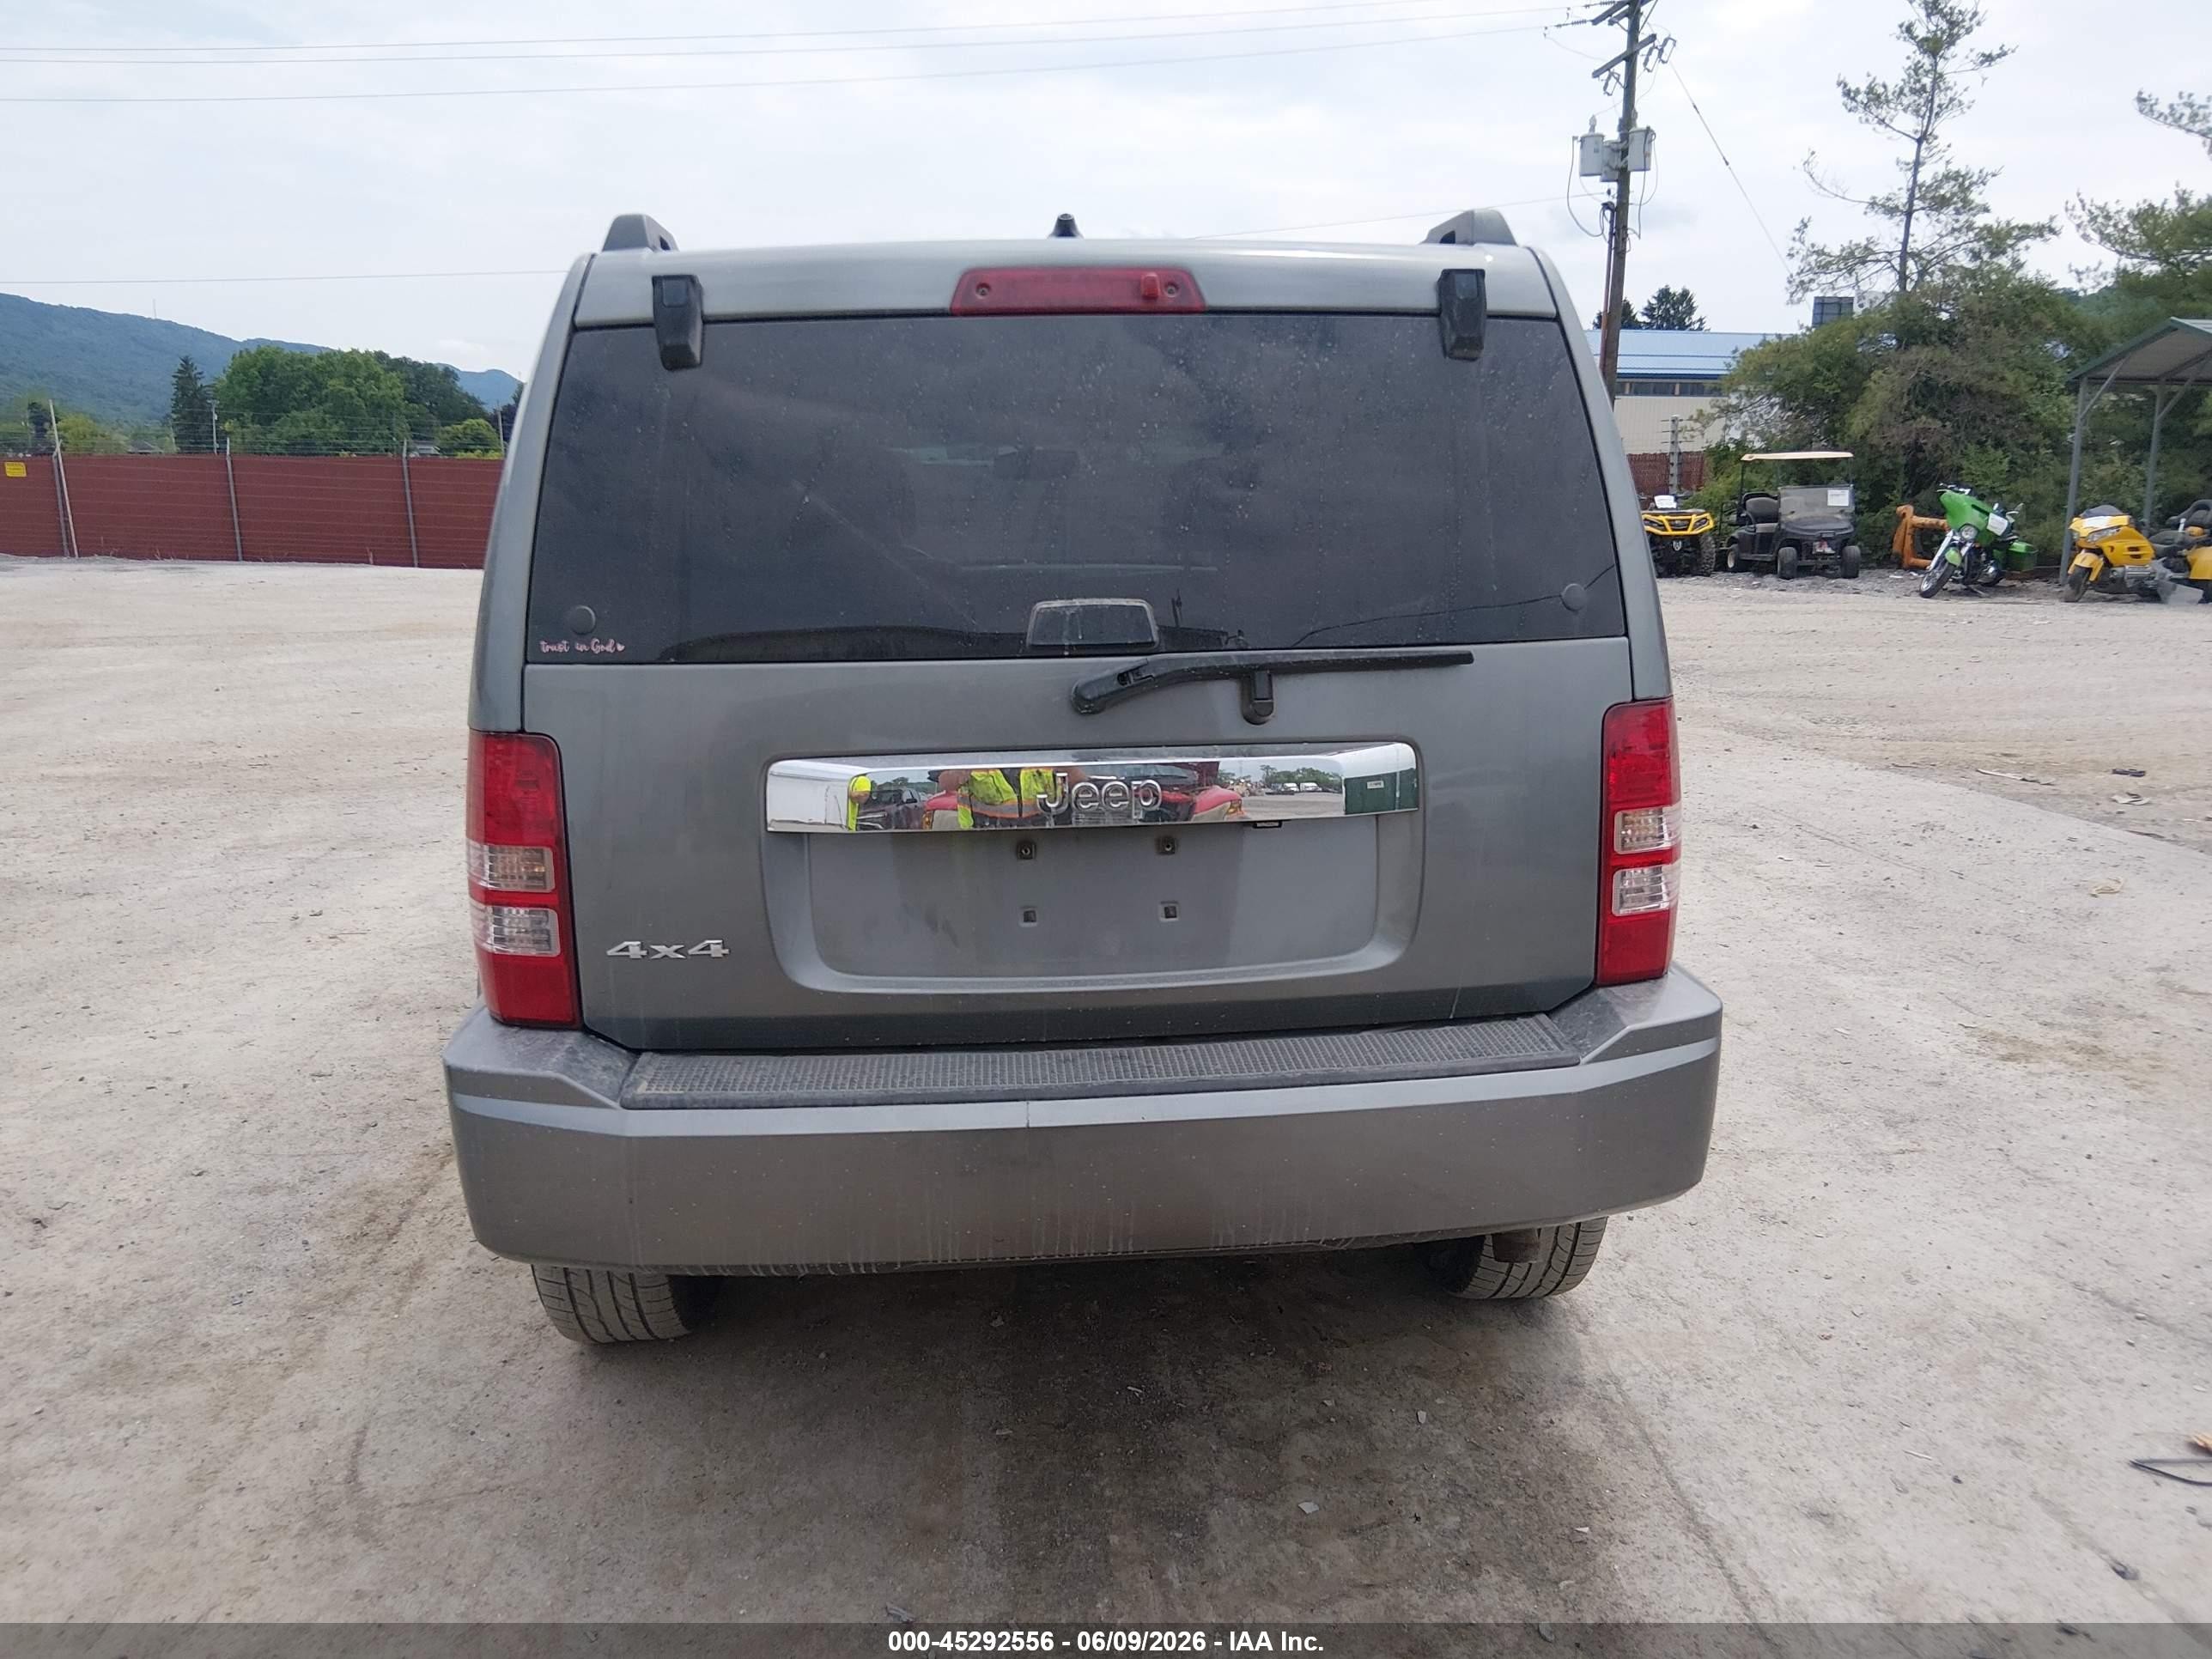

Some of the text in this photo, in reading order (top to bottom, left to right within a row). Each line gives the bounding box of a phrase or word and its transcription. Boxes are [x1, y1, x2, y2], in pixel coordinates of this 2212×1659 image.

[574, 642, 590, 653] in
[590, 637, 616, 653] God
[1036, 772, 1162, 819] Jeep
[605, 939, 730, 959] 4x4
